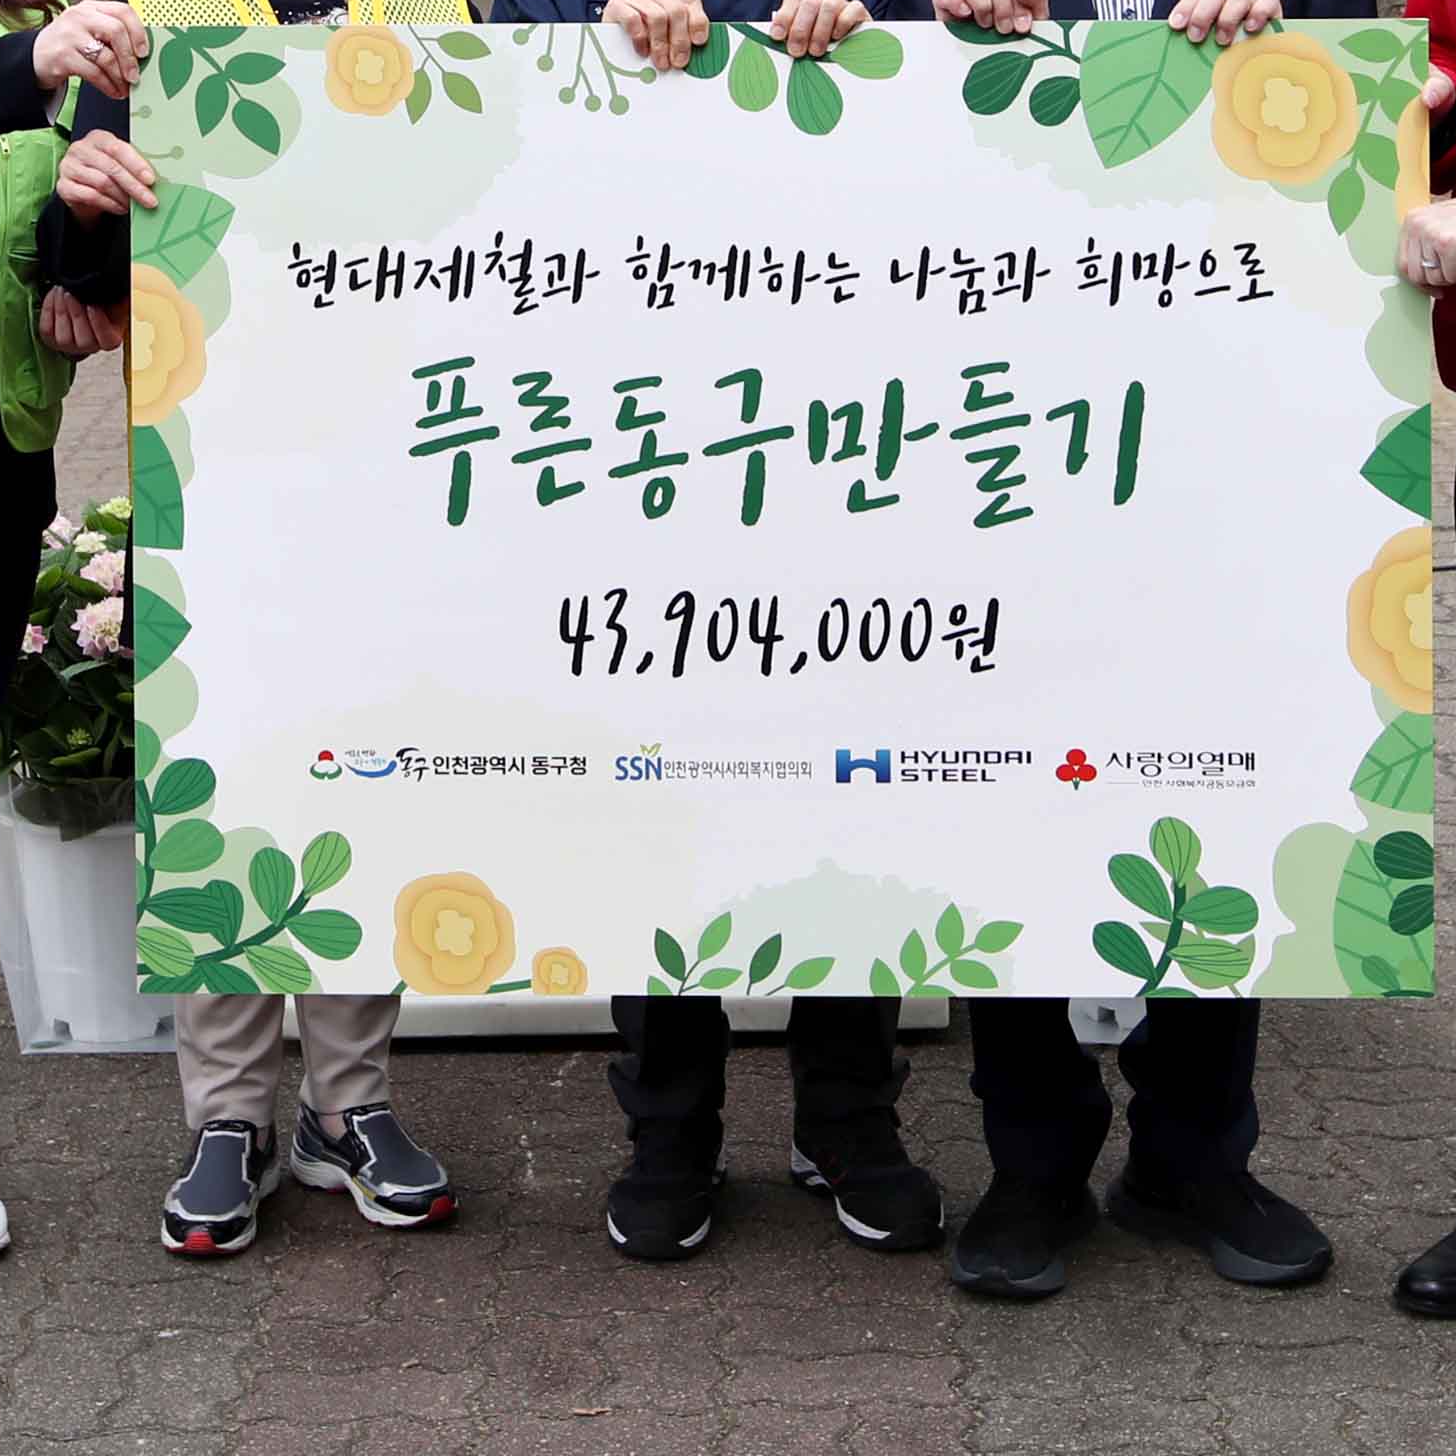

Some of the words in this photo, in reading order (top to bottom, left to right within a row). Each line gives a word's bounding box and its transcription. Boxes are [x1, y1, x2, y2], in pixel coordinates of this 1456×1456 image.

[287, 230, 601, 316] 현대제철과
[624, 234, 861, 310] 함께하는
[889, 245, 1052, 316] 나눔과
[1075, 236, 1275, 309] 희망으로
[408, 355, 1146, 529] 푸른동구만들기
[558, 587, 1000, 679] 43,904,000원
[432, 755, 526, 776] 인천광역시
[530, 755, 587, 776] 동구청
[615, 755, 662, 781] SSN
[900, 750, 1032, 765] HYUNDAI
[1105, 751, 1256, 778] 사랑의열매
[900, 768, 997, 783] STEEL
